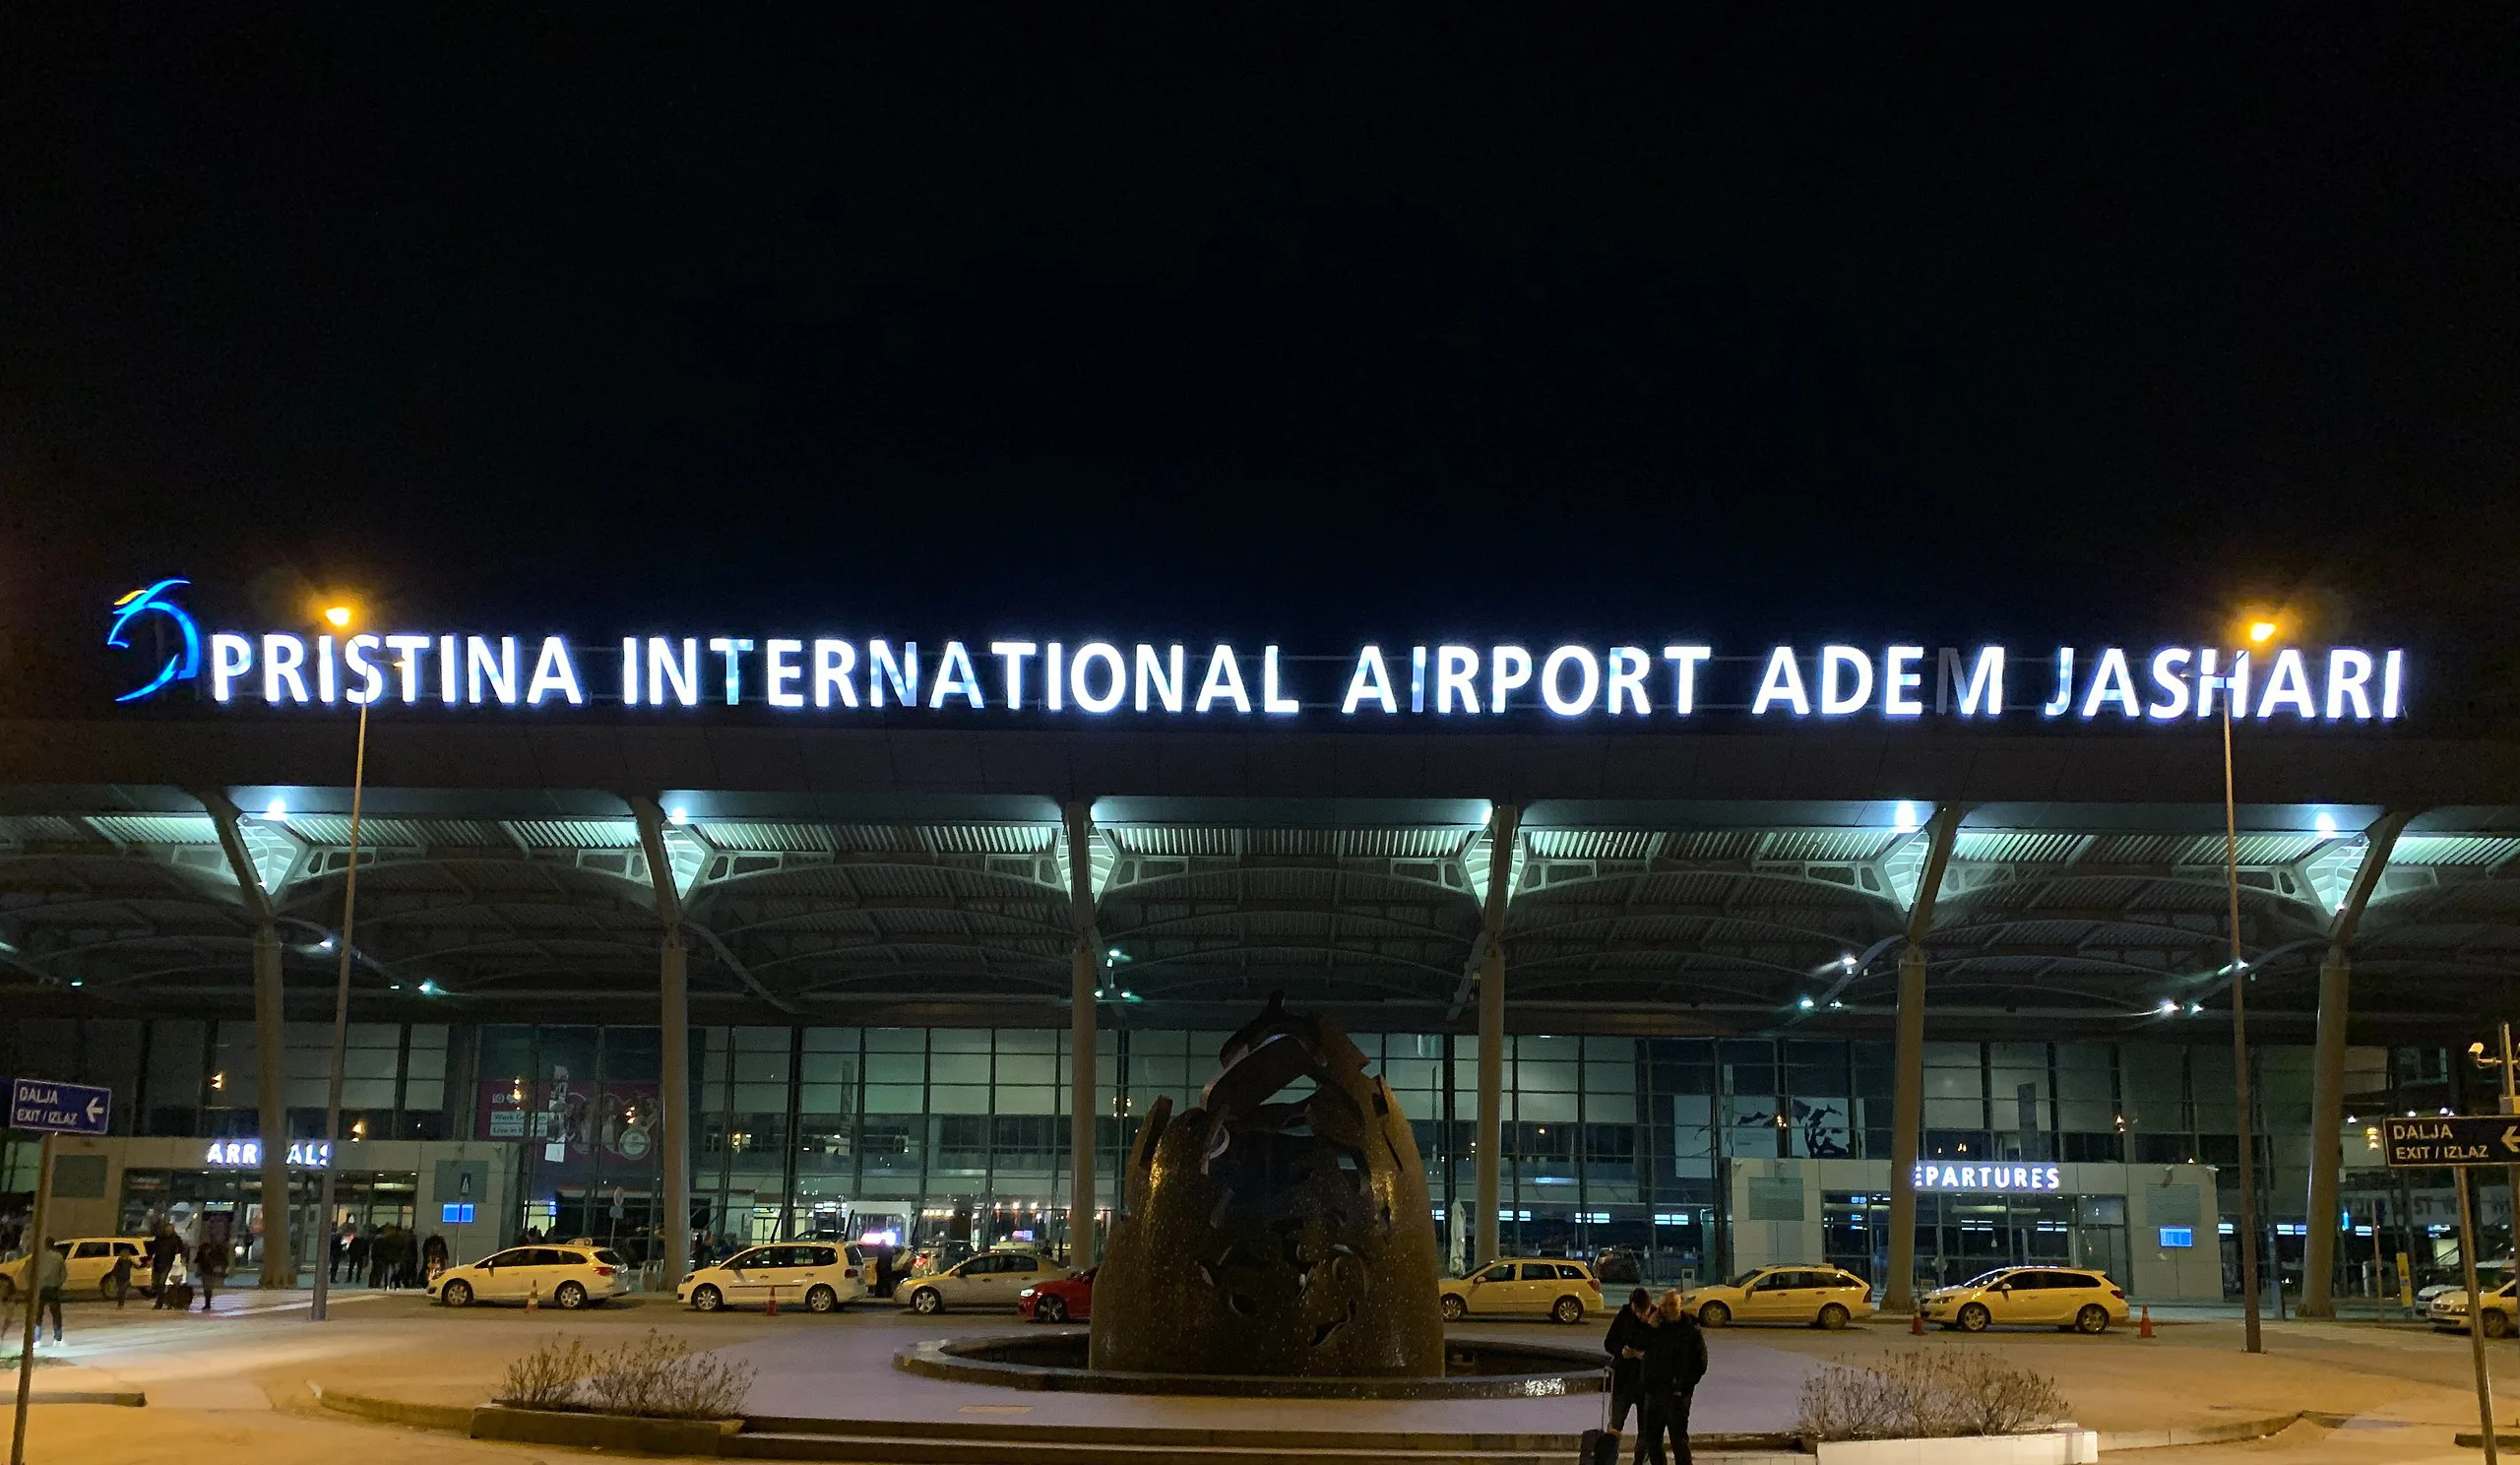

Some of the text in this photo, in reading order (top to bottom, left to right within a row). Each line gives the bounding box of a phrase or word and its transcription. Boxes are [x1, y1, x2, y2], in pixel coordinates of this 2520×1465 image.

[211, 633, 2404, 720] PRISTINA INTERNATIONAL AIRPORT ADEM JASHARI
[20, 1086, 58, 1104] DALJA
[17, 1109, 41, 1122] EXIT
[47, 1111, 78, 1125] IZLAZ
[2393, 1123, 2453, 1140] DALJA
[2395, 1146, 2430, 1160] EXIT
[2443, 1145, 2488, 1159] IZLAZ
